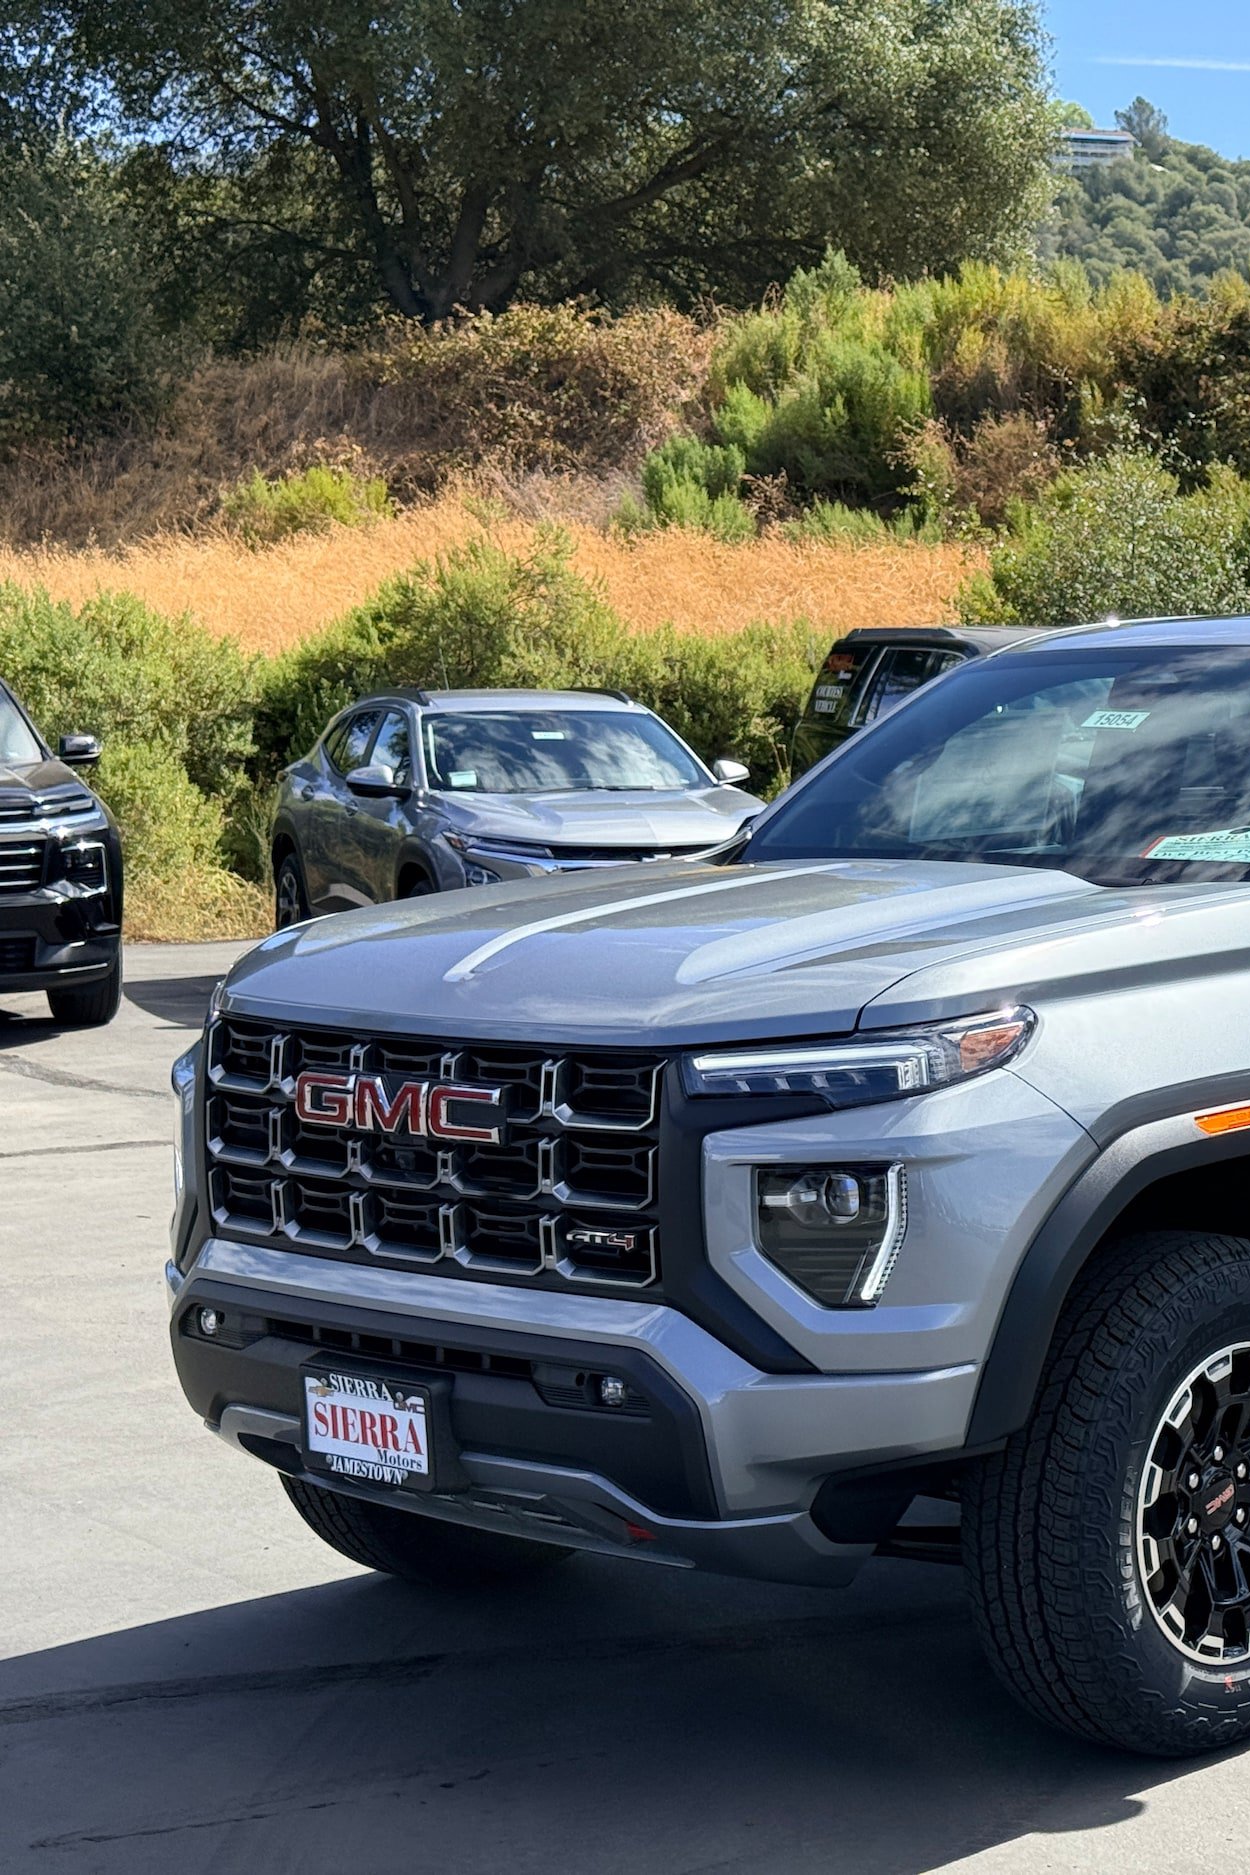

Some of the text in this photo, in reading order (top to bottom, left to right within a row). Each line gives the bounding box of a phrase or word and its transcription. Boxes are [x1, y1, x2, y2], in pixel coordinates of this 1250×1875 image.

[1094, 713, 1139, 726] 15054
[295, 1071, 500, 1143] GMC
[566, 1229, 635, 1252] AT4
[328, 1373, 395, 1402] SIERRA
[313, 1401, 425, 1456] SIERRA
[331, 1455, 402, 1485] JAMESTOWN
[376, 1449, 423, 1471] Motors
[1205, 1483, 1235, 1516] GMC
